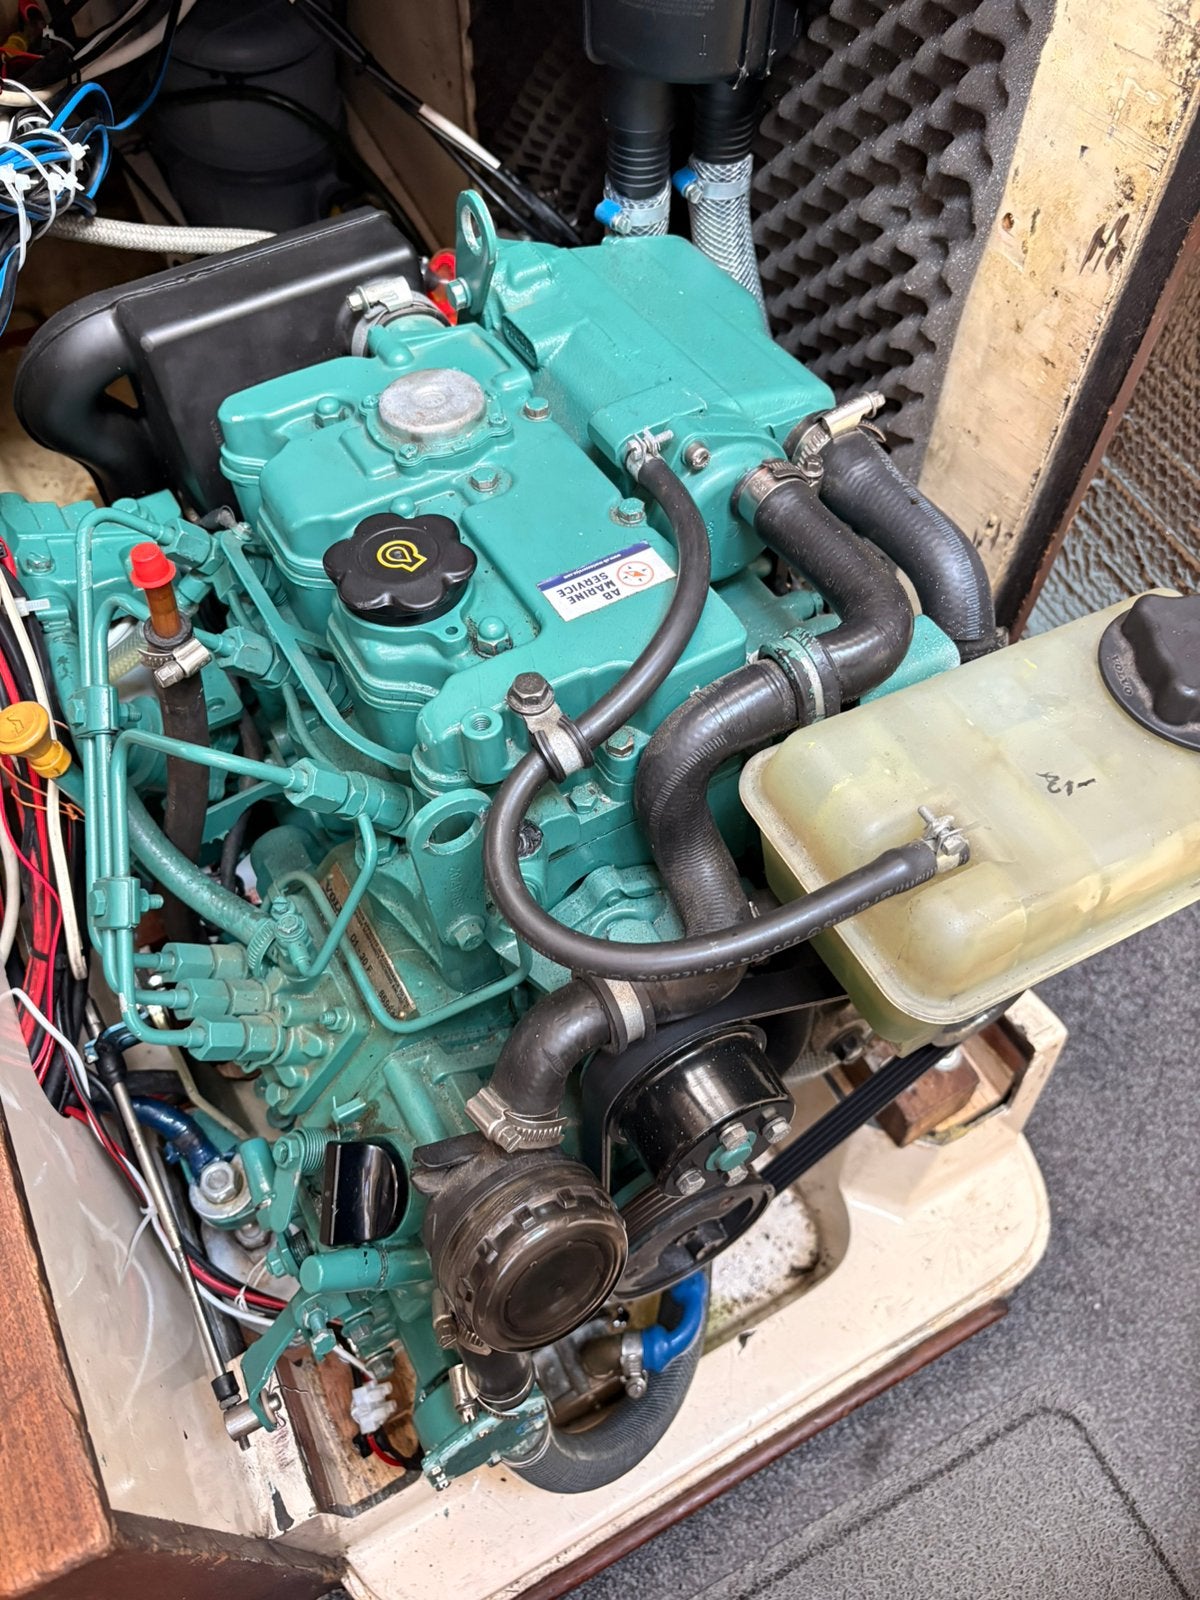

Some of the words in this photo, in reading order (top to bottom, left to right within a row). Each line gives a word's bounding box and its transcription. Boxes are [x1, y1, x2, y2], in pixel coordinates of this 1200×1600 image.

[556, 572, 609, 598] SERVICE
[566, 580, 616, 605] MARINE
[602, 588, 621, 600] AB
[1112, 654, 1134, 697] VOLVO
